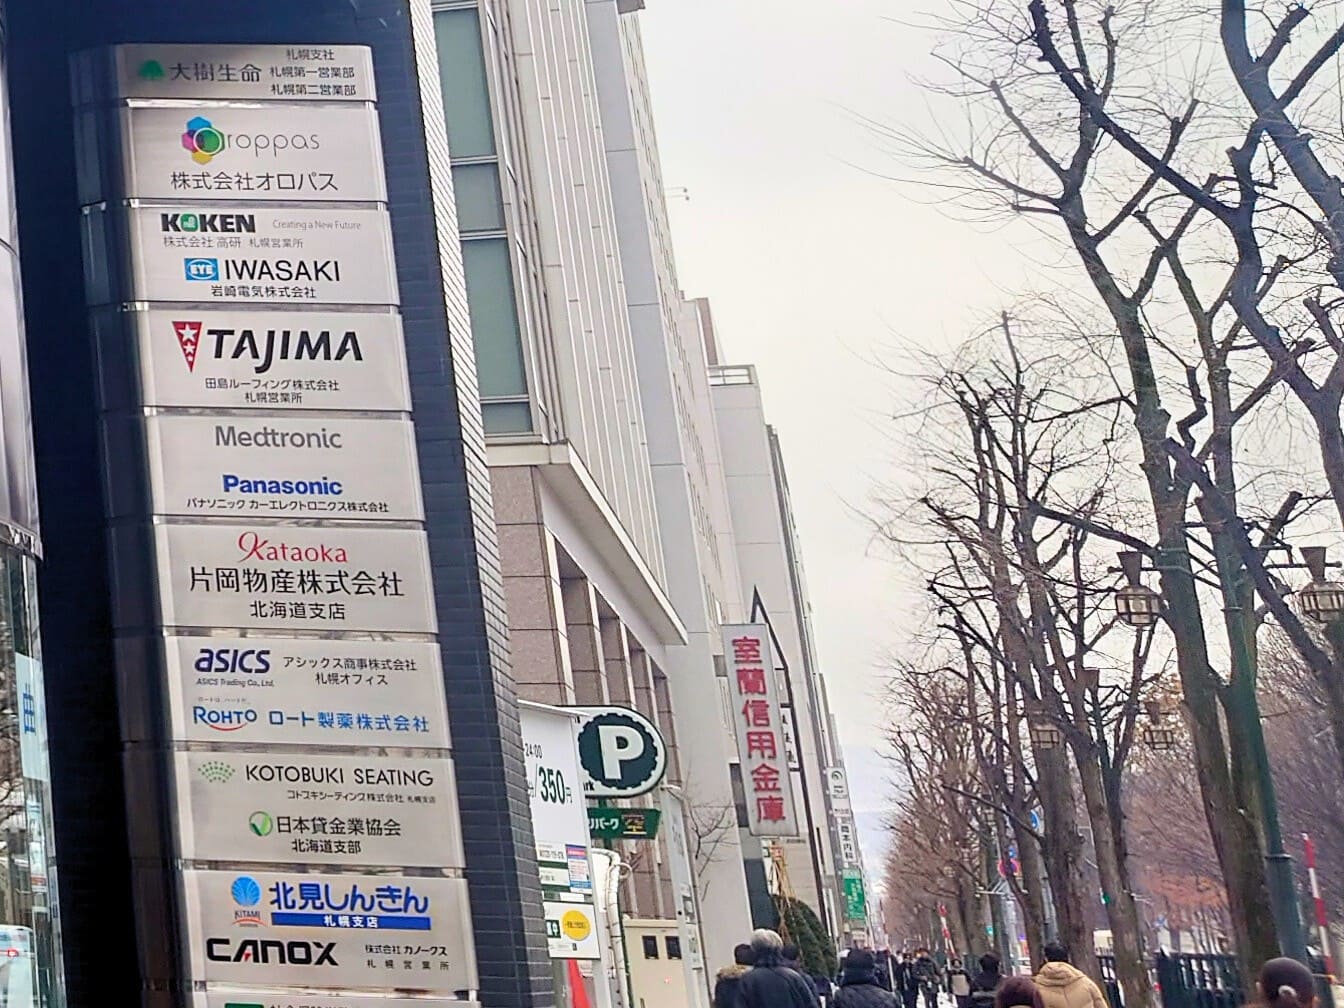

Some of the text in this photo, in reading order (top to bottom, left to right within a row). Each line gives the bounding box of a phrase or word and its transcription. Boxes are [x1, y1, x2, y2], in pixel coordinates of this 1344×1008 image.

[286, 48, 335, 61] 札幌支社
[169, 63, 262, 83] 大樹生命
[269, 67, 355, 79] 札幌第一営業部
[271, 84, 357, 97] 札幌第二営業部
[170, 171, 339, 191] 株式会社オロパス
[161, 213, 256, 233] KOKEN
[272, 219, 307, 231] Creating
[314, 220, 335, 230] New
[336, 220, 362, 230] Future
[163, 236, 213, 248] 株式会社
[225, 260, 340, 282] IWASAKI
[211, 285, 317, 299] 岩崎電気株式会社
[207, 329, 363, 374] TAJIMA
[205, 378, 340, 391] 田島ルーフィング株式会社
[245, 392, 303, 403] 札幌営業所
[215, 426, 343, 449] Medtronic
[222, 475, 343, 495] Panasonic
[238, 532, 348, 563] Kataoka
[190, 567, 404, 596] 片岡物産株式会社
[250, 601, 345, 620] 北海道支店
[283, 656, 417, 671] アシックス商事株式会社
[315, 673, 388, 686] 札幌オフィス
[269, 711, 429, 732] ロート製薬株式会社
[731, 636, 786, 824] 室蘭信用金庫
[598, 725, 644, 780] P
[246, 765, 434, 787] KOTOBUKI SEATING
[276, 816, 401, 836] 日本貸金業協会
[292, 839, 361, 854] 北海道支部
[269, 882, 429, 913] 北見しんきん
[323, 915, 378, 928] 札幌支店
